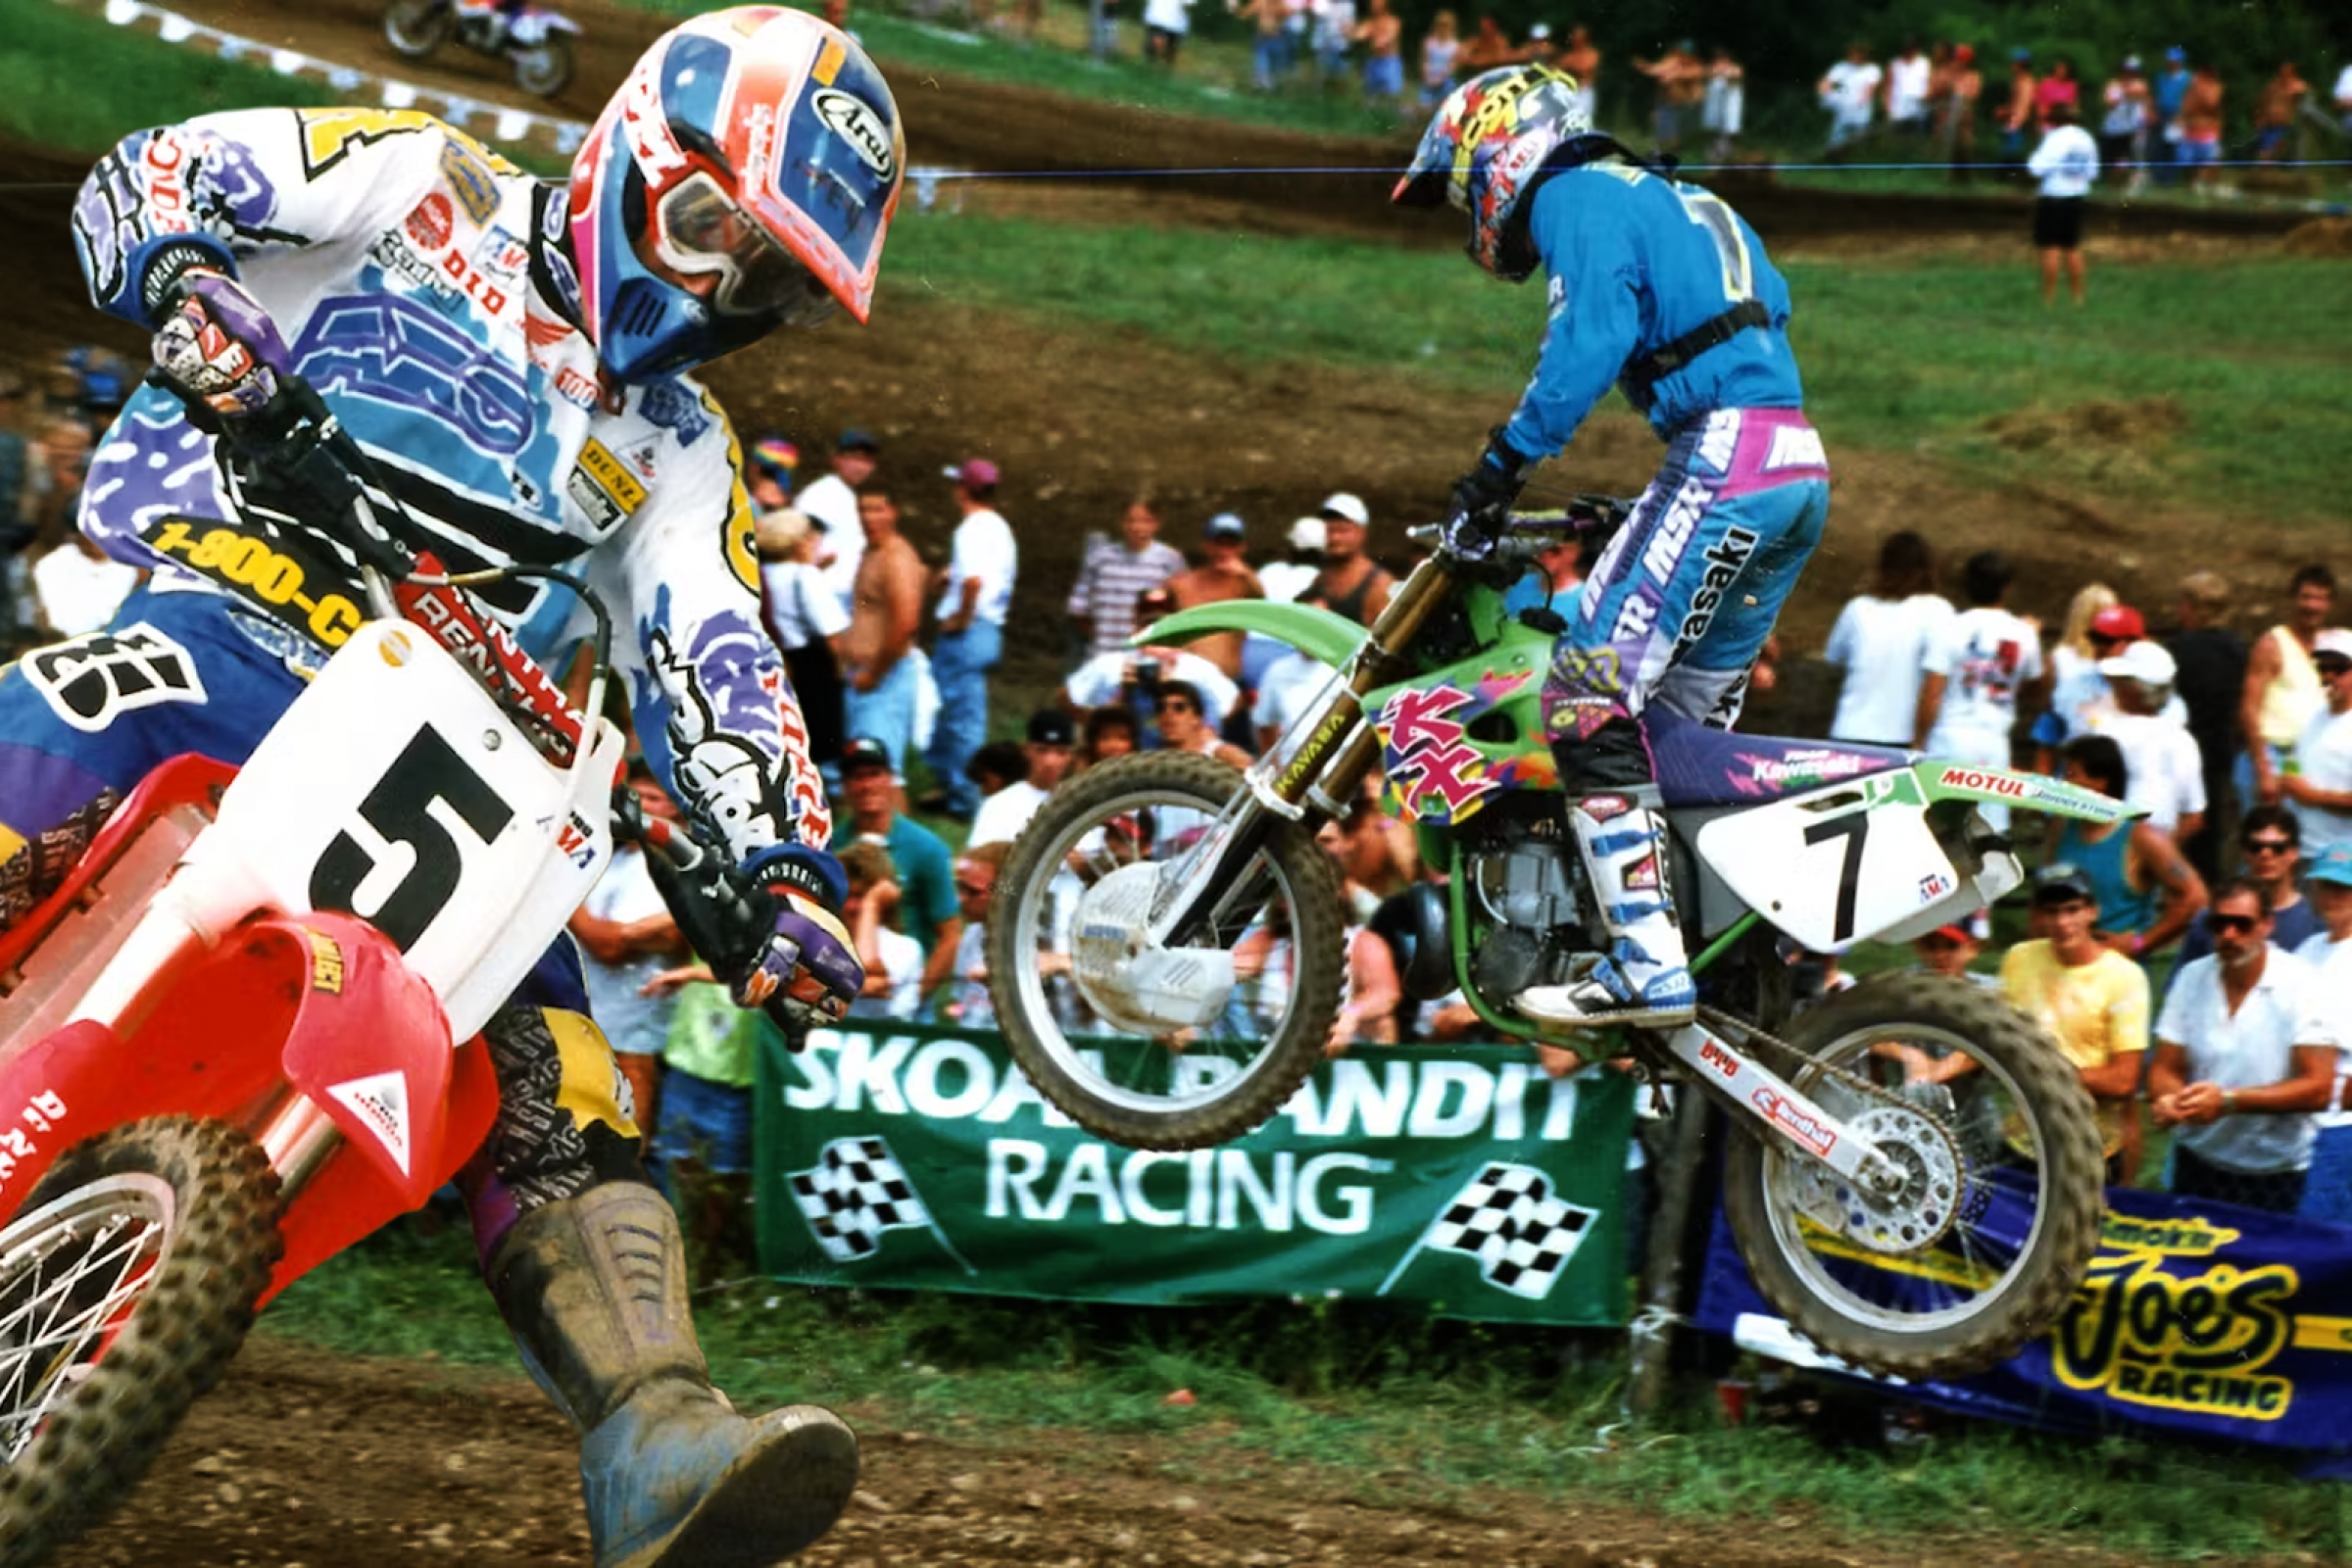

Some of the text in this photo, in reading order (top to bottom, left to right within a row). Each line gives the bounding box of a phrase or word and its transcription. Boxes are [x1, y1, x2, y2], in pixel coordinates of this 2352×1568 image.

[443, 249, 508, 317] DID
[585, 447, 644, 504] DUNL
[151, 519, 378, 651] 1-800-C
[1941, 769, 2025, 798] MOTUL
[308, 719, 516, 956] 5
[1803, 809, 1870, 944] 7
[984, 1137, 1378, 1235] RACING
[2117, 1364, 2287, 1413] RACING
